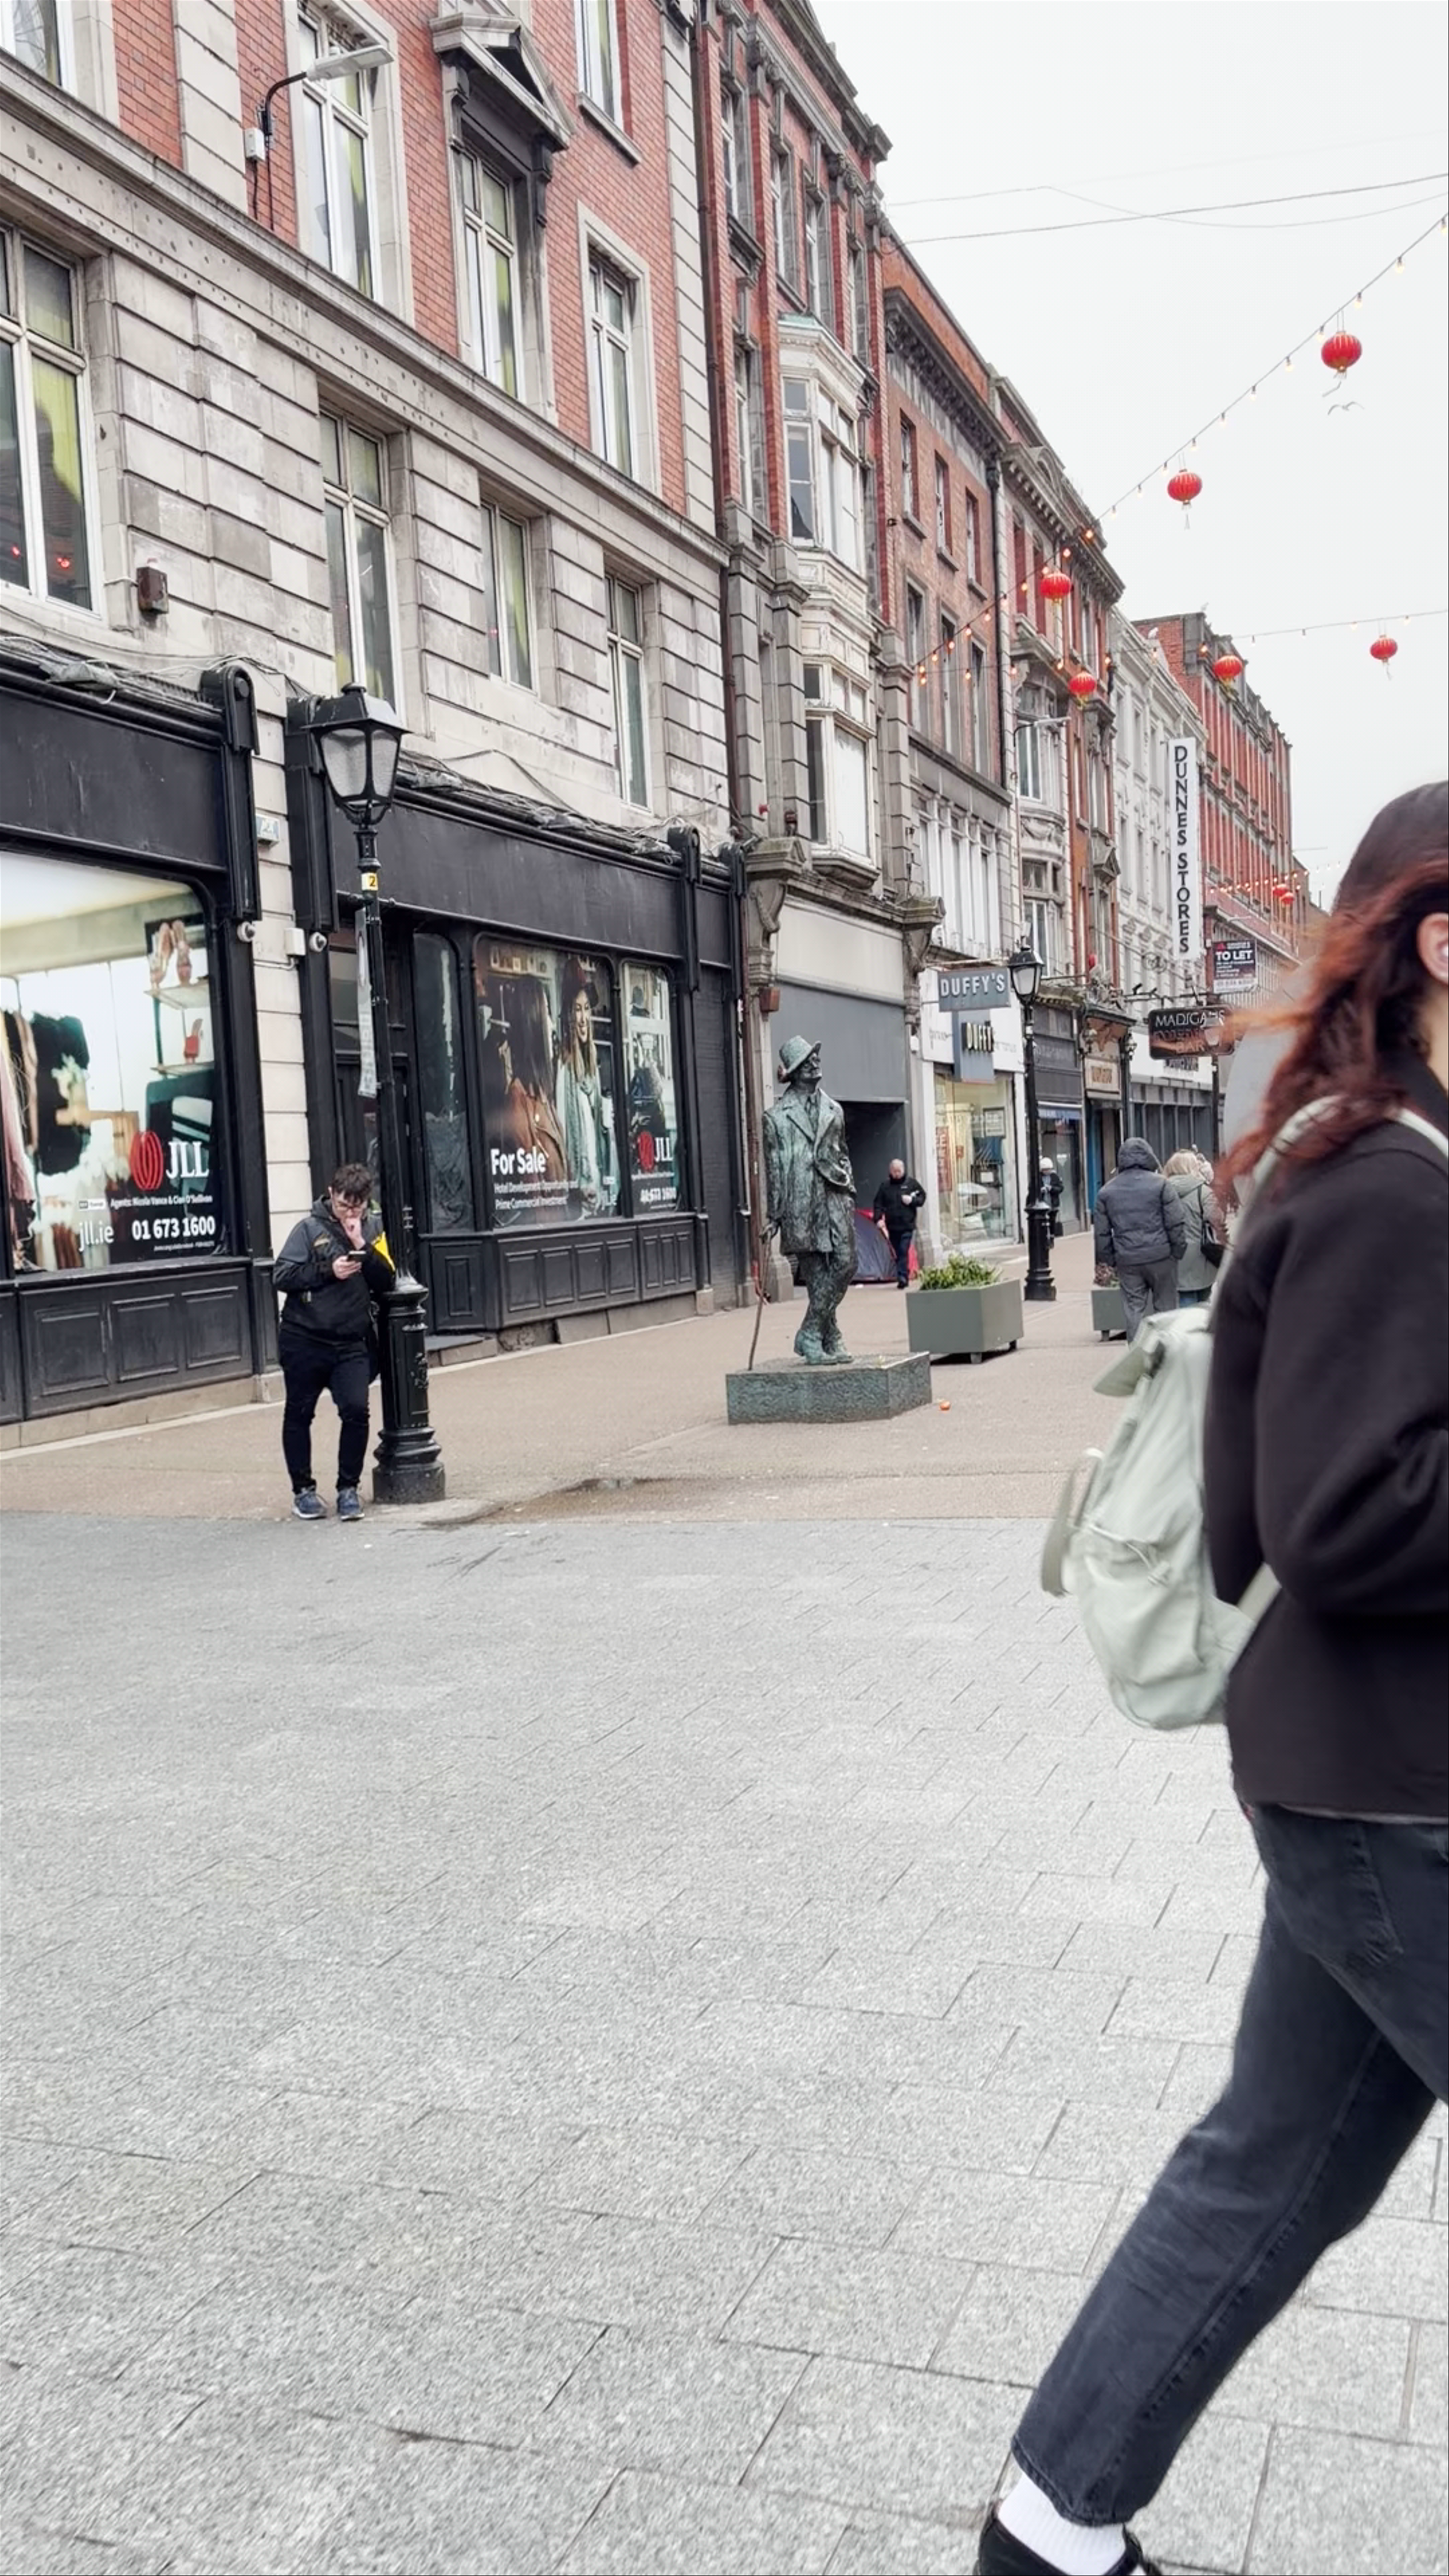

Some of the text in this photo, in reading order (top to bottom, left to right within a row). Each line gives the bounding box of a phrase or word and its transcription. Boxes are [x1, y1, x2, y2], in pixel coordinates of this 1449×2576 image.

[1174, 745, 1190, 954] DUNNES STORES
[369, 875, 376, 887] 2
[1215, 949, 1253, 961] TO LET
[941, 972, 1005, 997] DUFFY'S
[166, 1141, 209, 1179] JLL
[491, 1146, 546, 1175] For Sale
[654, 1137, 673, 1162] JLL
[78, 1215, 216, 1252] jll.ie 01 673 1600
